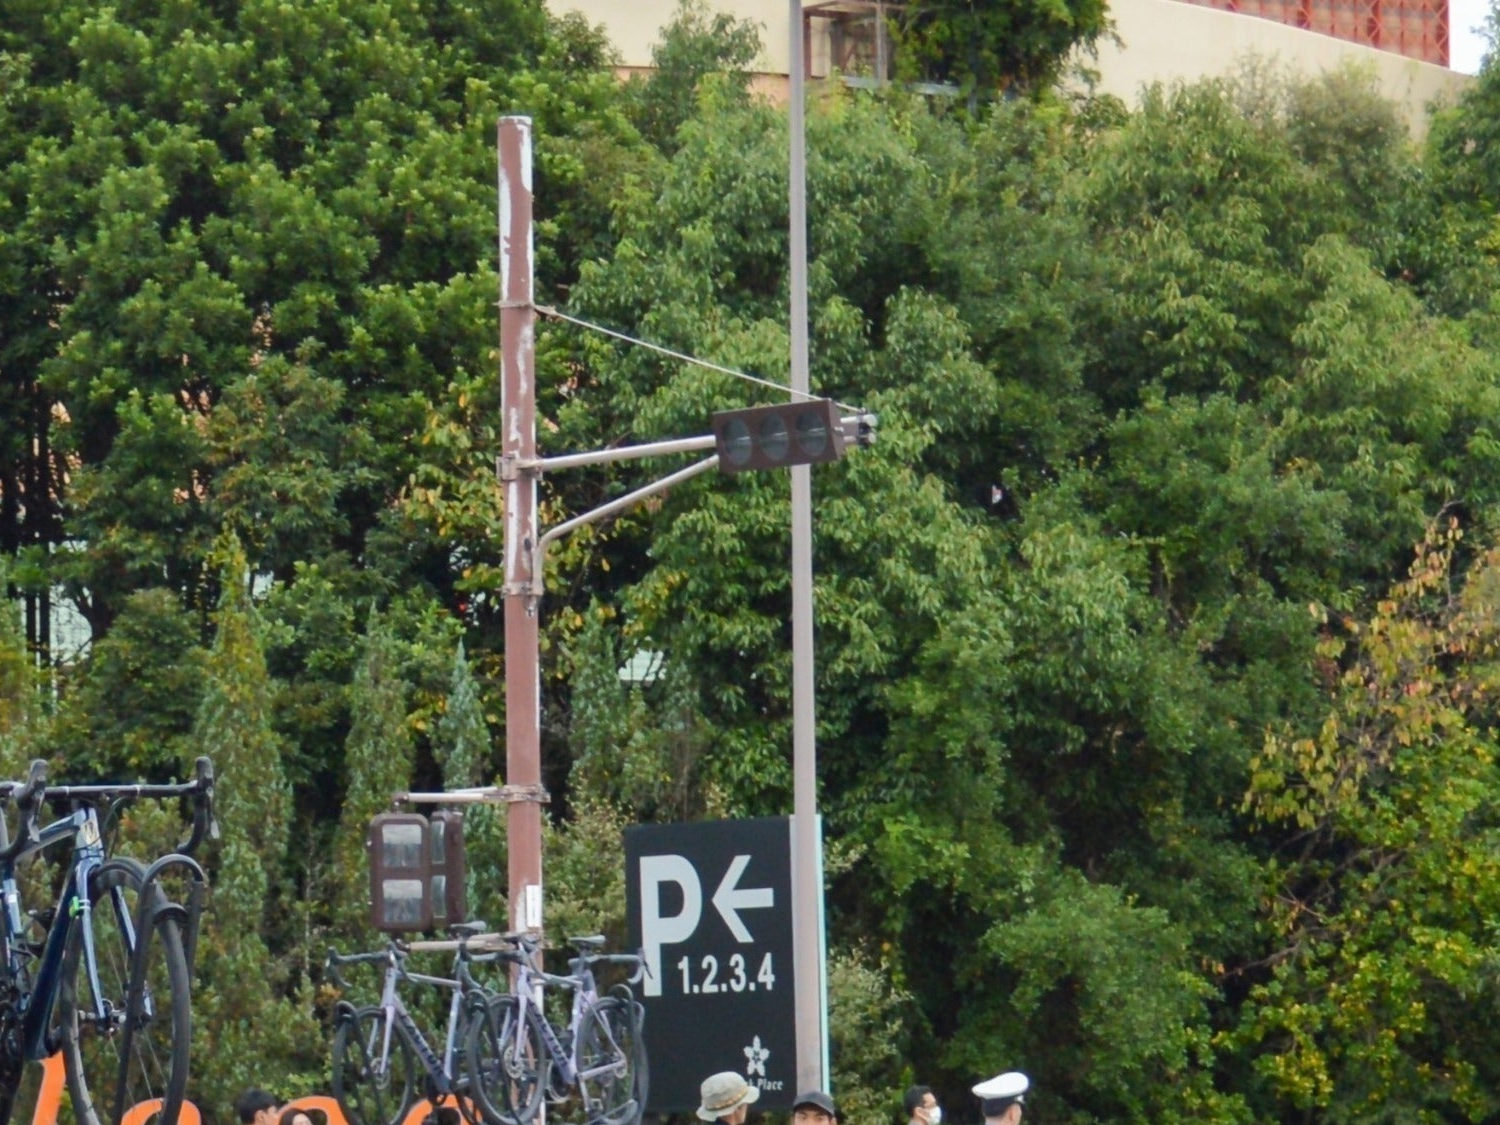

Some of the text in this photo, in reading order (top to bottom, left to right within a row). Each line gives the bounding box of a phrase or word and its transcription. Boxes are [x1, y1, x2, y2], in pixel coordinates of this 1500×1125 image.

[639, 854, 702, 997] P
[677, 952, 775, 994] 1.2.3.4
[757, 1078, 783, 1091] Place
